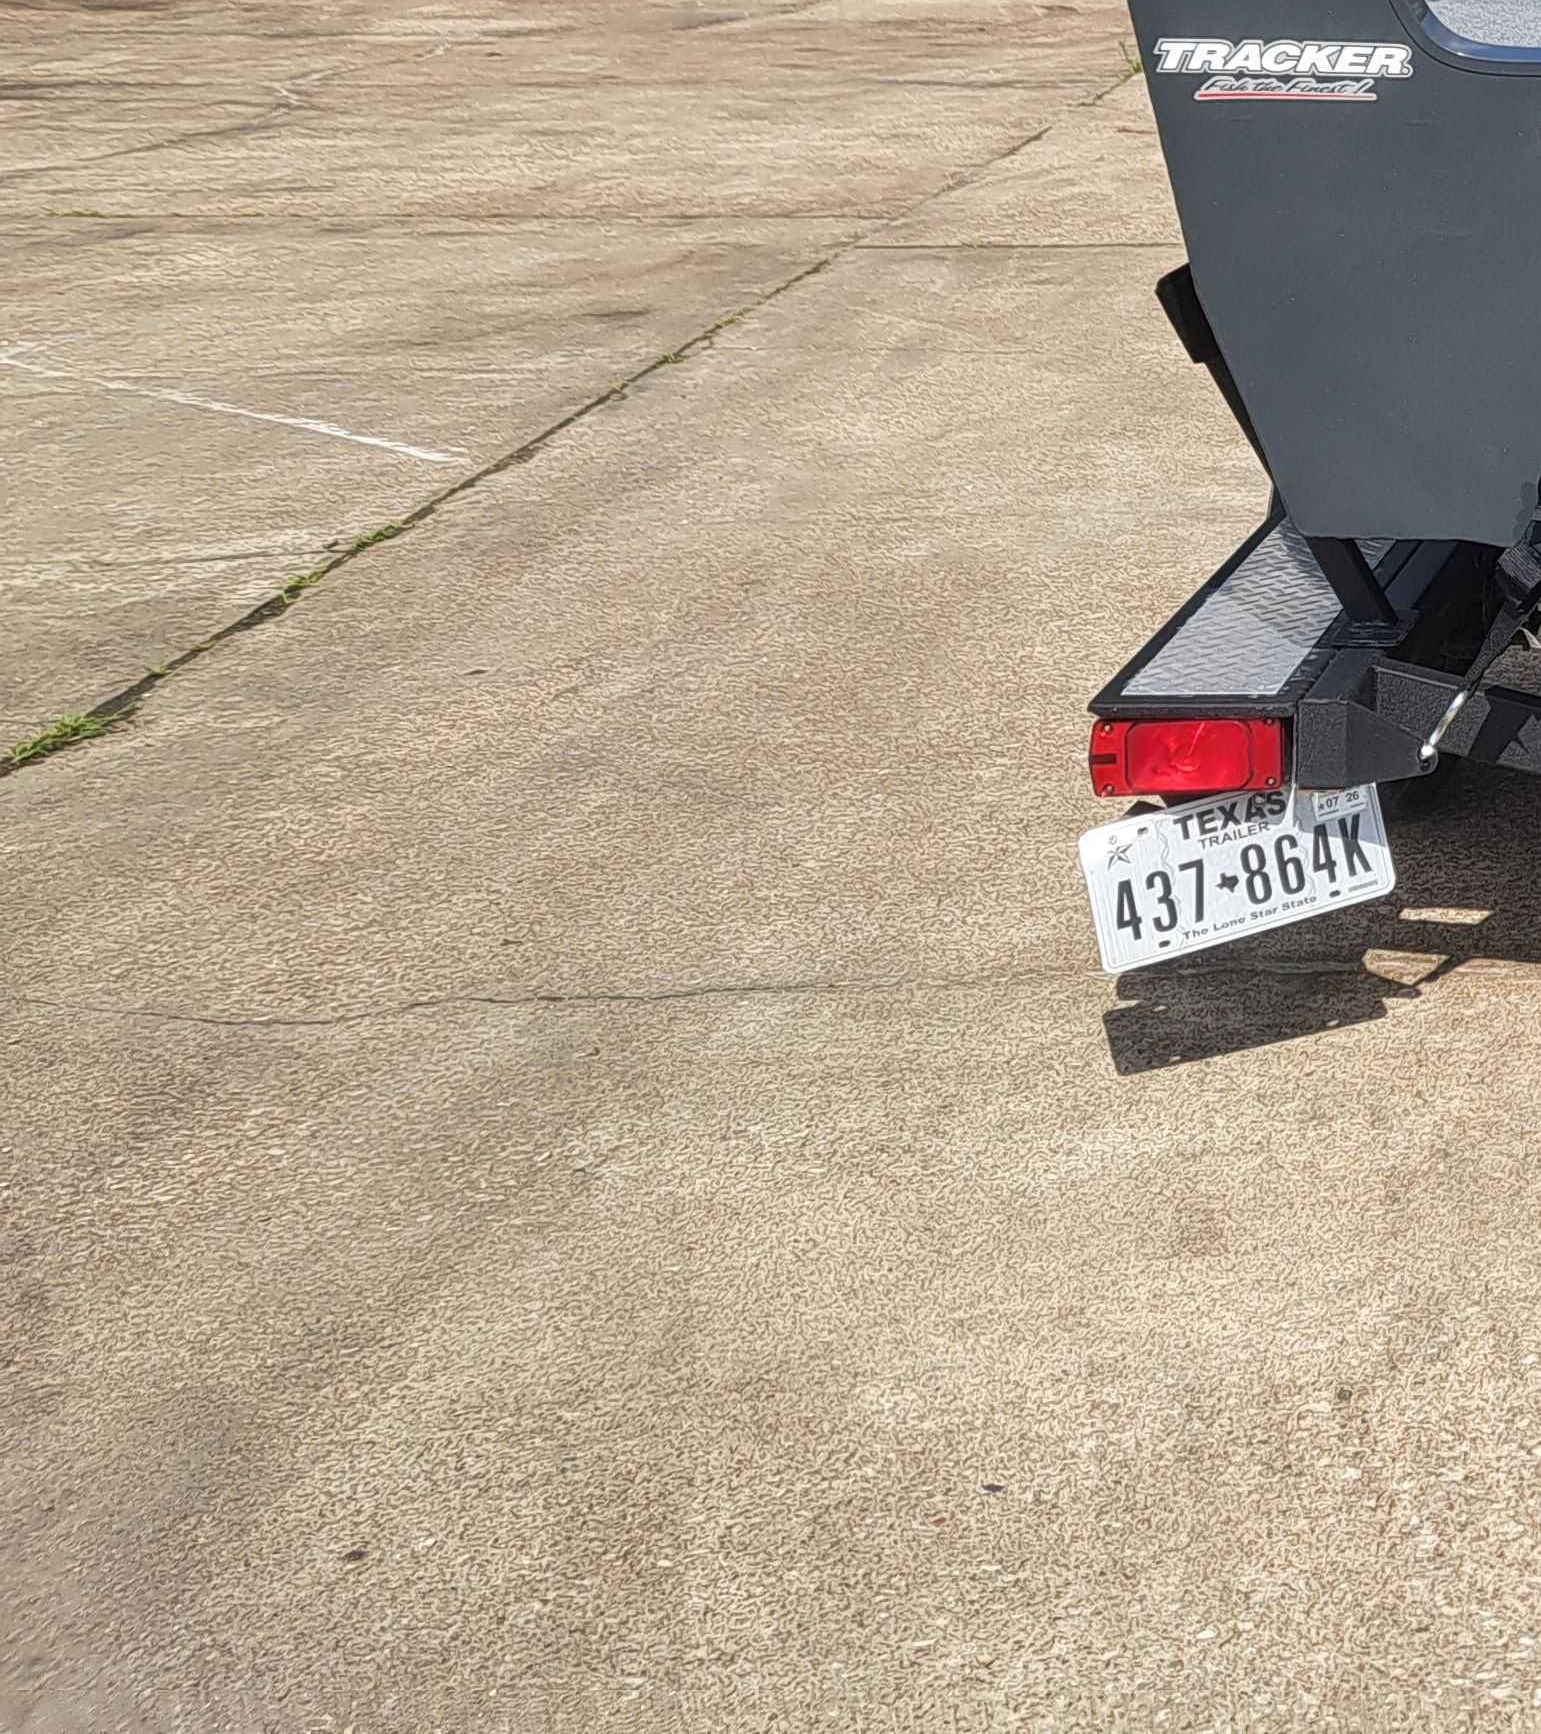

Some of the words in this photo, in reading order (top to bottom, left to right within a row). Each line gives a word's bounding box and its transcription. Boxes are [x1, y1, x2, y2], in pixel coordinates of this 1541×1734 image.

[1172, 790, 1287, 841] TEXAS
[1325, 796, 1341, 810] 07
[1345, 790, 1360, 804] 26
[1197, 820, 1271, 851] TRAILER
[1182, 925, 1210, 942] The
[1212, 914, 1248, 933] Lone
[1249, 905, 1279, 923] Star
[1281, 894, 1319, 912] State
